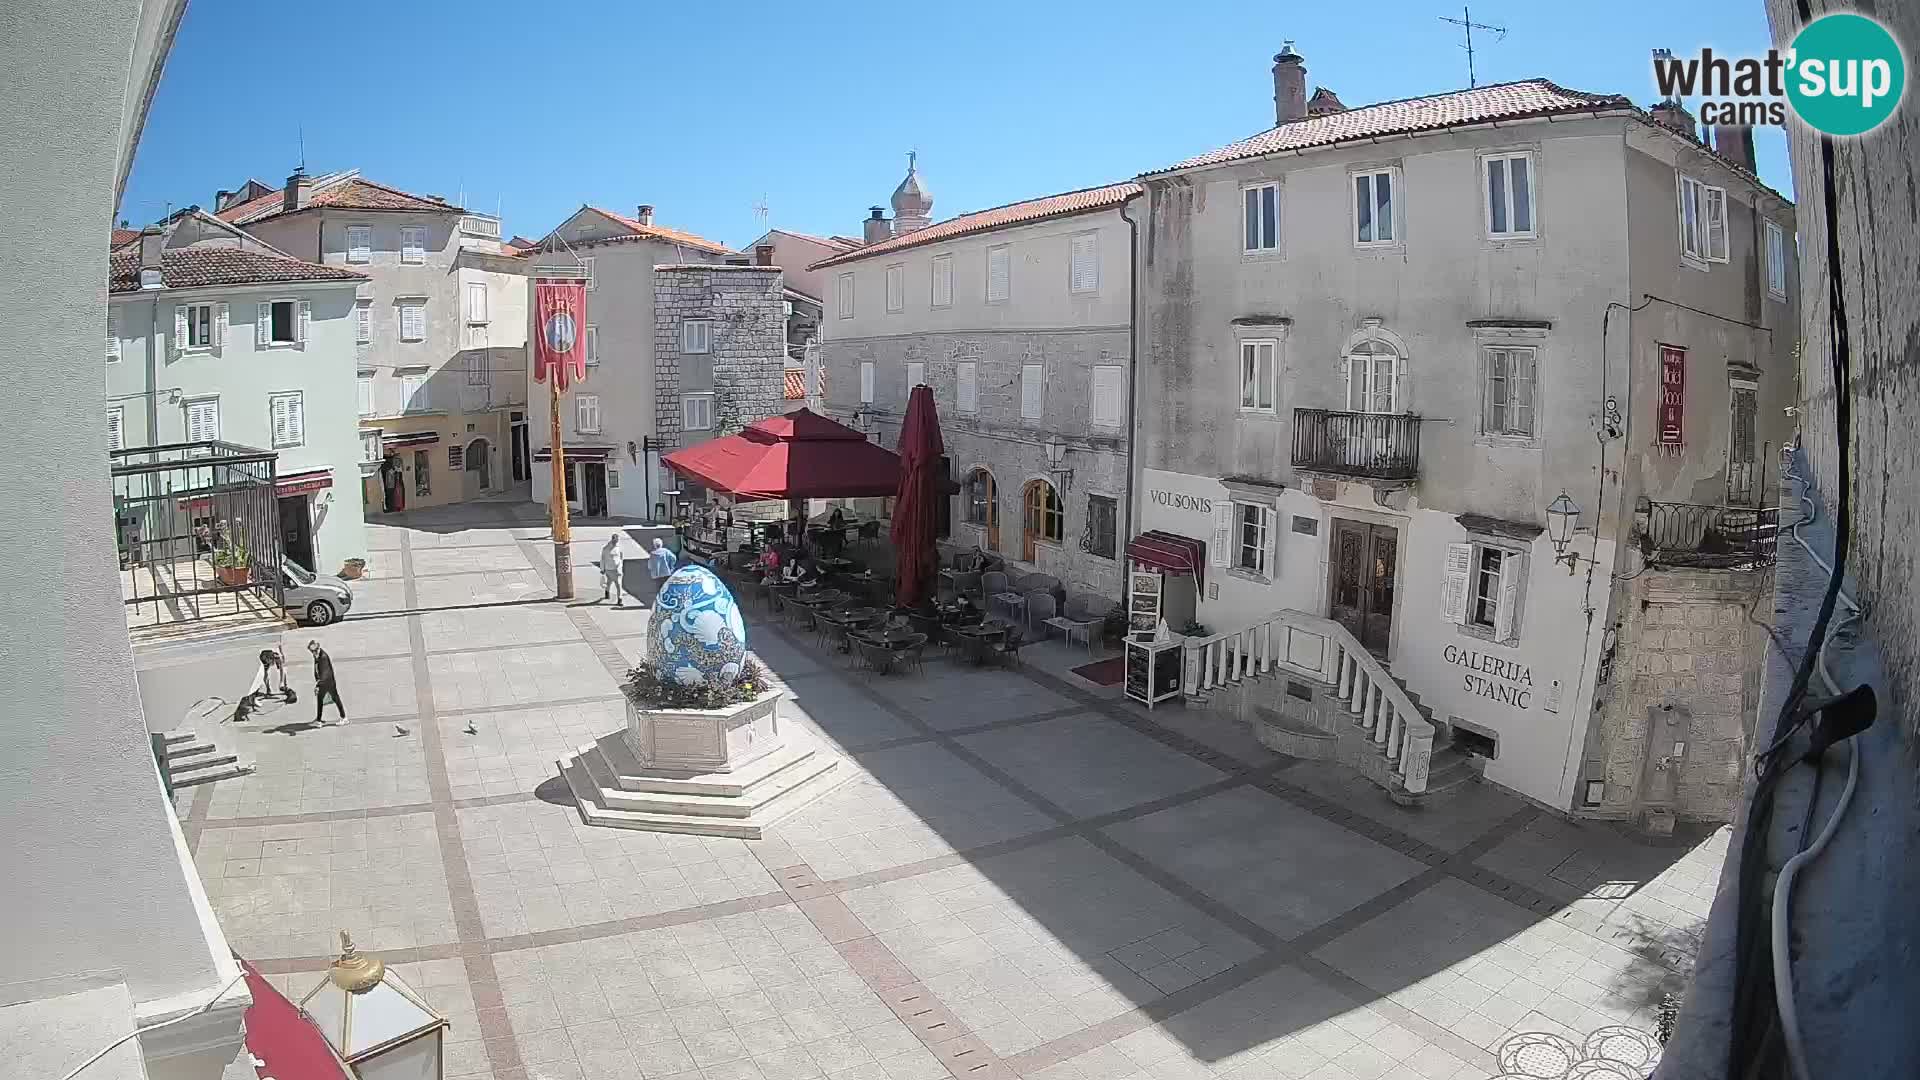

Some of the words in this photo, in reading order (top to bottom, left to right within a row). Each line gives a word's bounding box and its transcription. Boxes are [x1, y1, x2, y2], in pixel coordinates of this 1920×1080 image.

[1150, 489, 1212, 514] VOLSONIS
[1443, 644, 1533, 687] GALERIJA
[1463, 674, 1531, 710] STANIĆ
